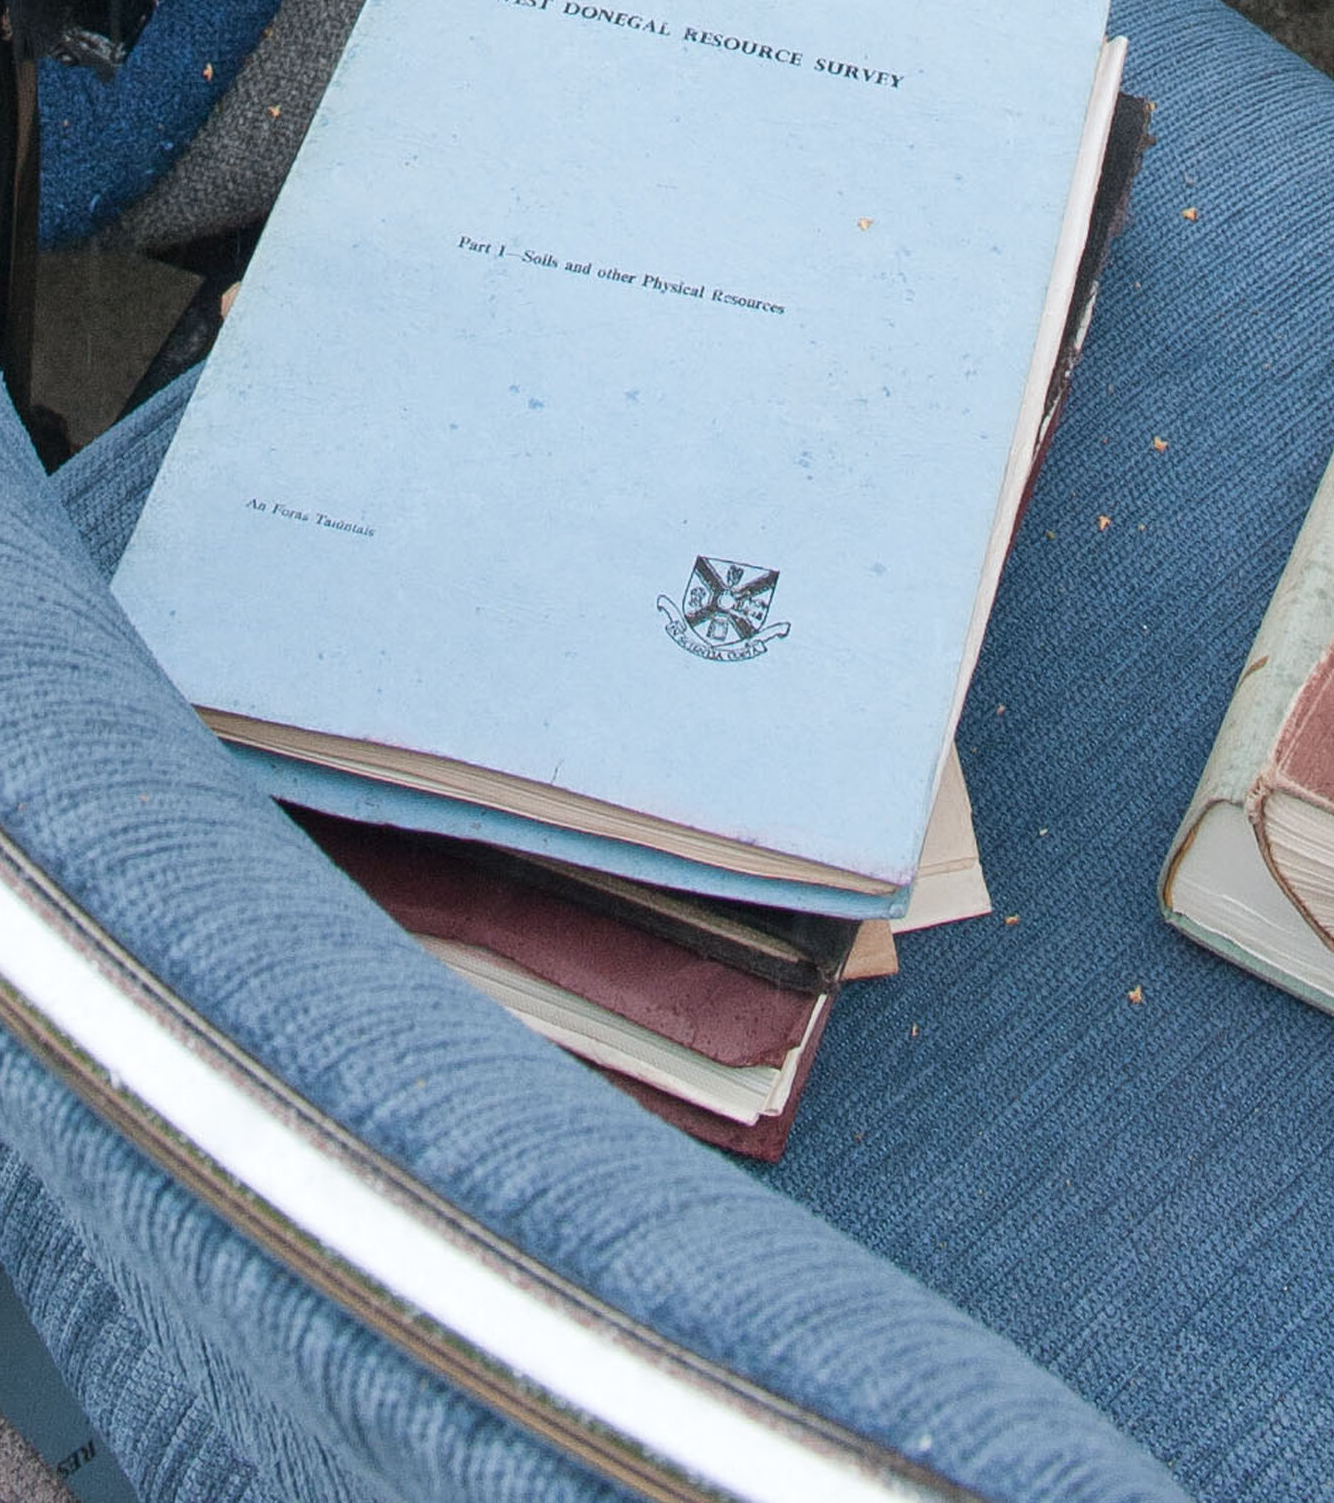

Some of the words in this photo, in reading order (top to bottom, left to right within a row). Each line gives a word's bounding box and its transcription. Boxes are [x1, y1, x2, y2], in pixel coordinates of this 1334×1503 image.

[563, 1, 671, 37] DONEGAL
[683, 26, 804, 68] RESOURCE
[813, 57, 906, 89] SURVEY
[458, 235, 492, 255] Part
[564, 259, 592, 276] and
[597, 265, 637, 285] other
[641, 273, 705, 300] Physical
[711, 289, 786, 316] Resources
[245, 497, 267, 512] An
